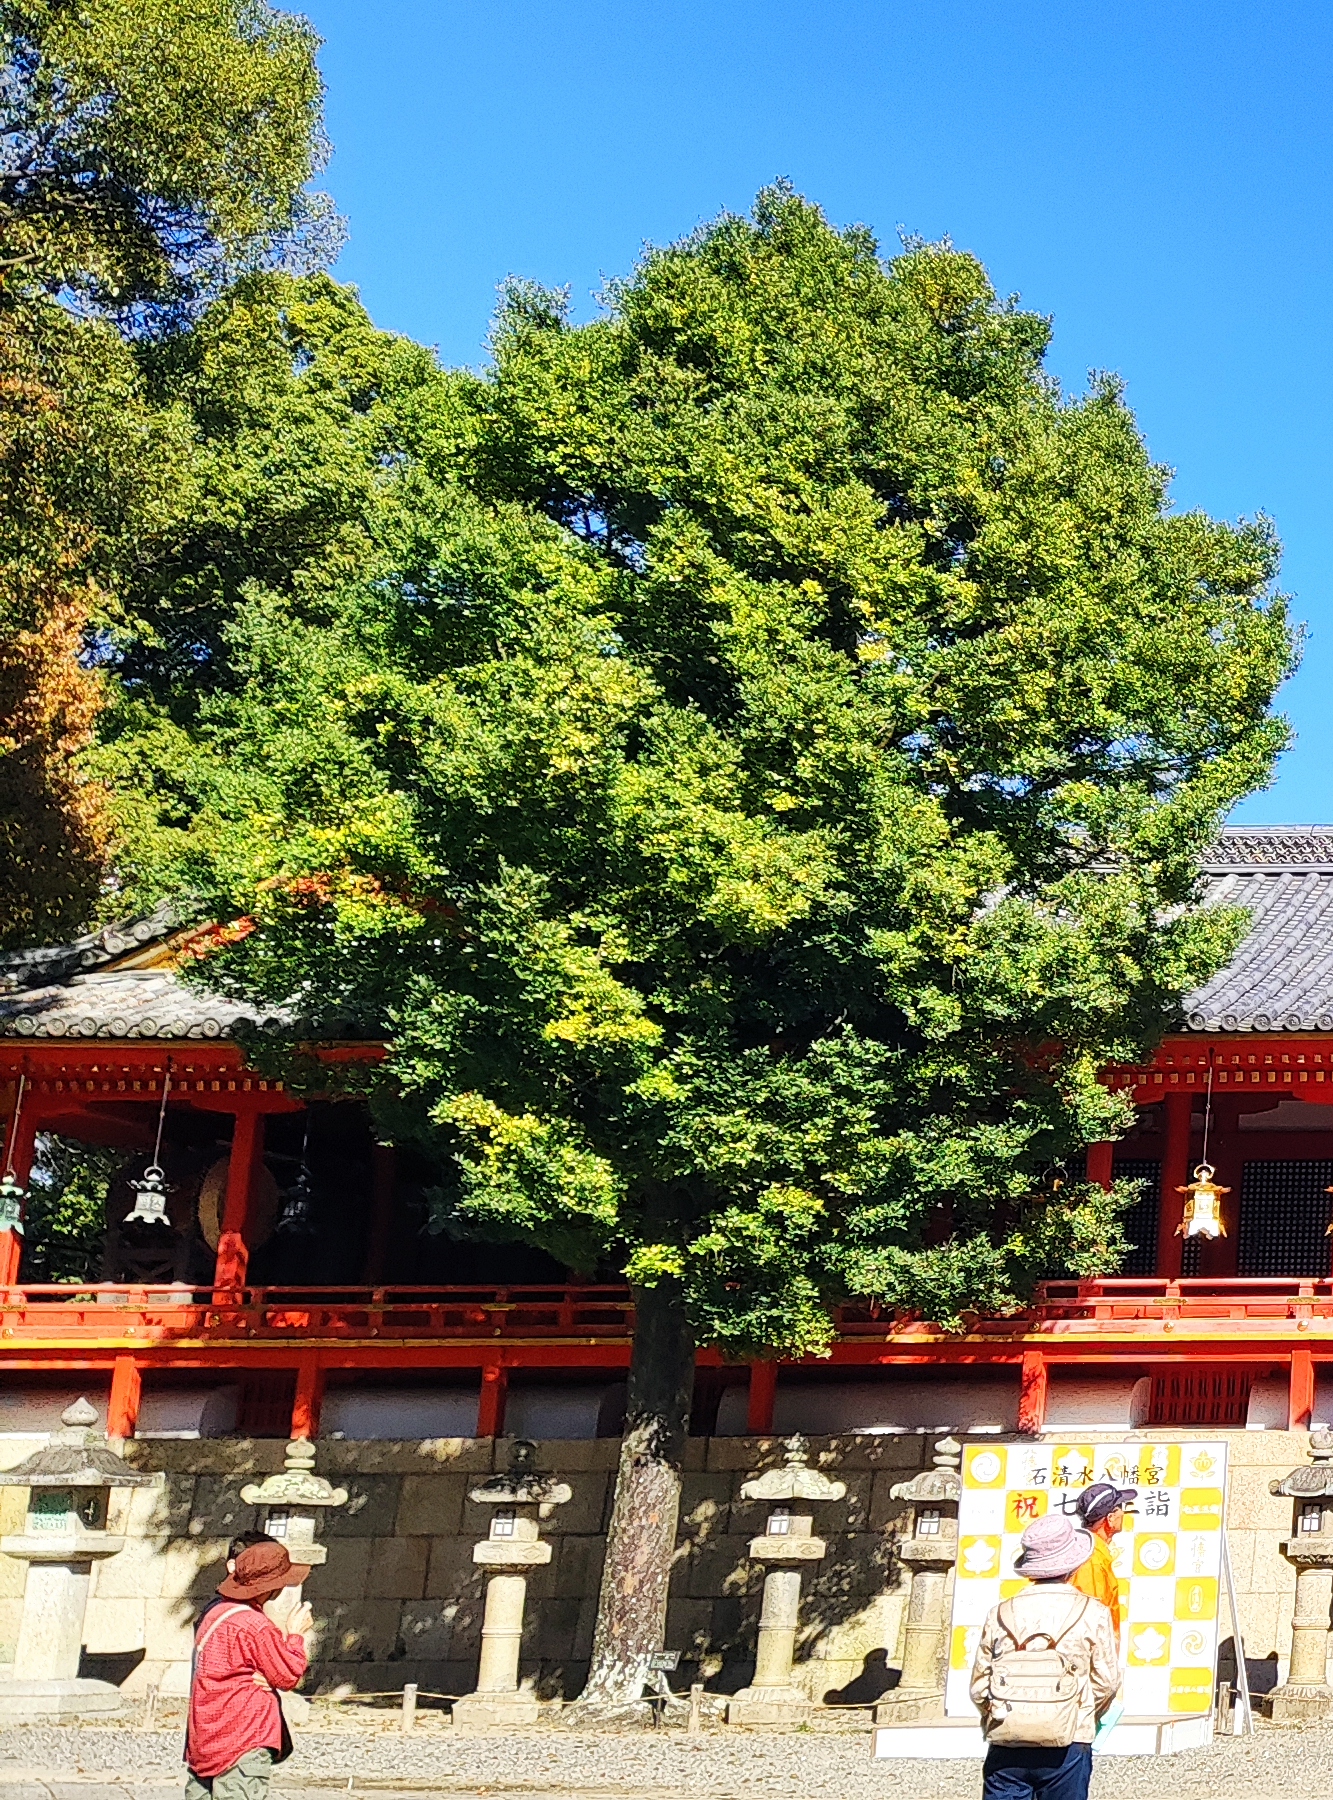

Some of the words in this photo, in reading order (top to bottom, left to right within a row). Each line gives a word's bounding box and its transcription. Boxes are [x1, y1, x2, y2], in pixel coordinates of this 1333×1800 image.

[1031, 1464, 1165, 1486] 石清水八幡宮
[1012, 1493, 1039, 1518] 祝
[1053, 1490, 1171, 1517] 七詣
